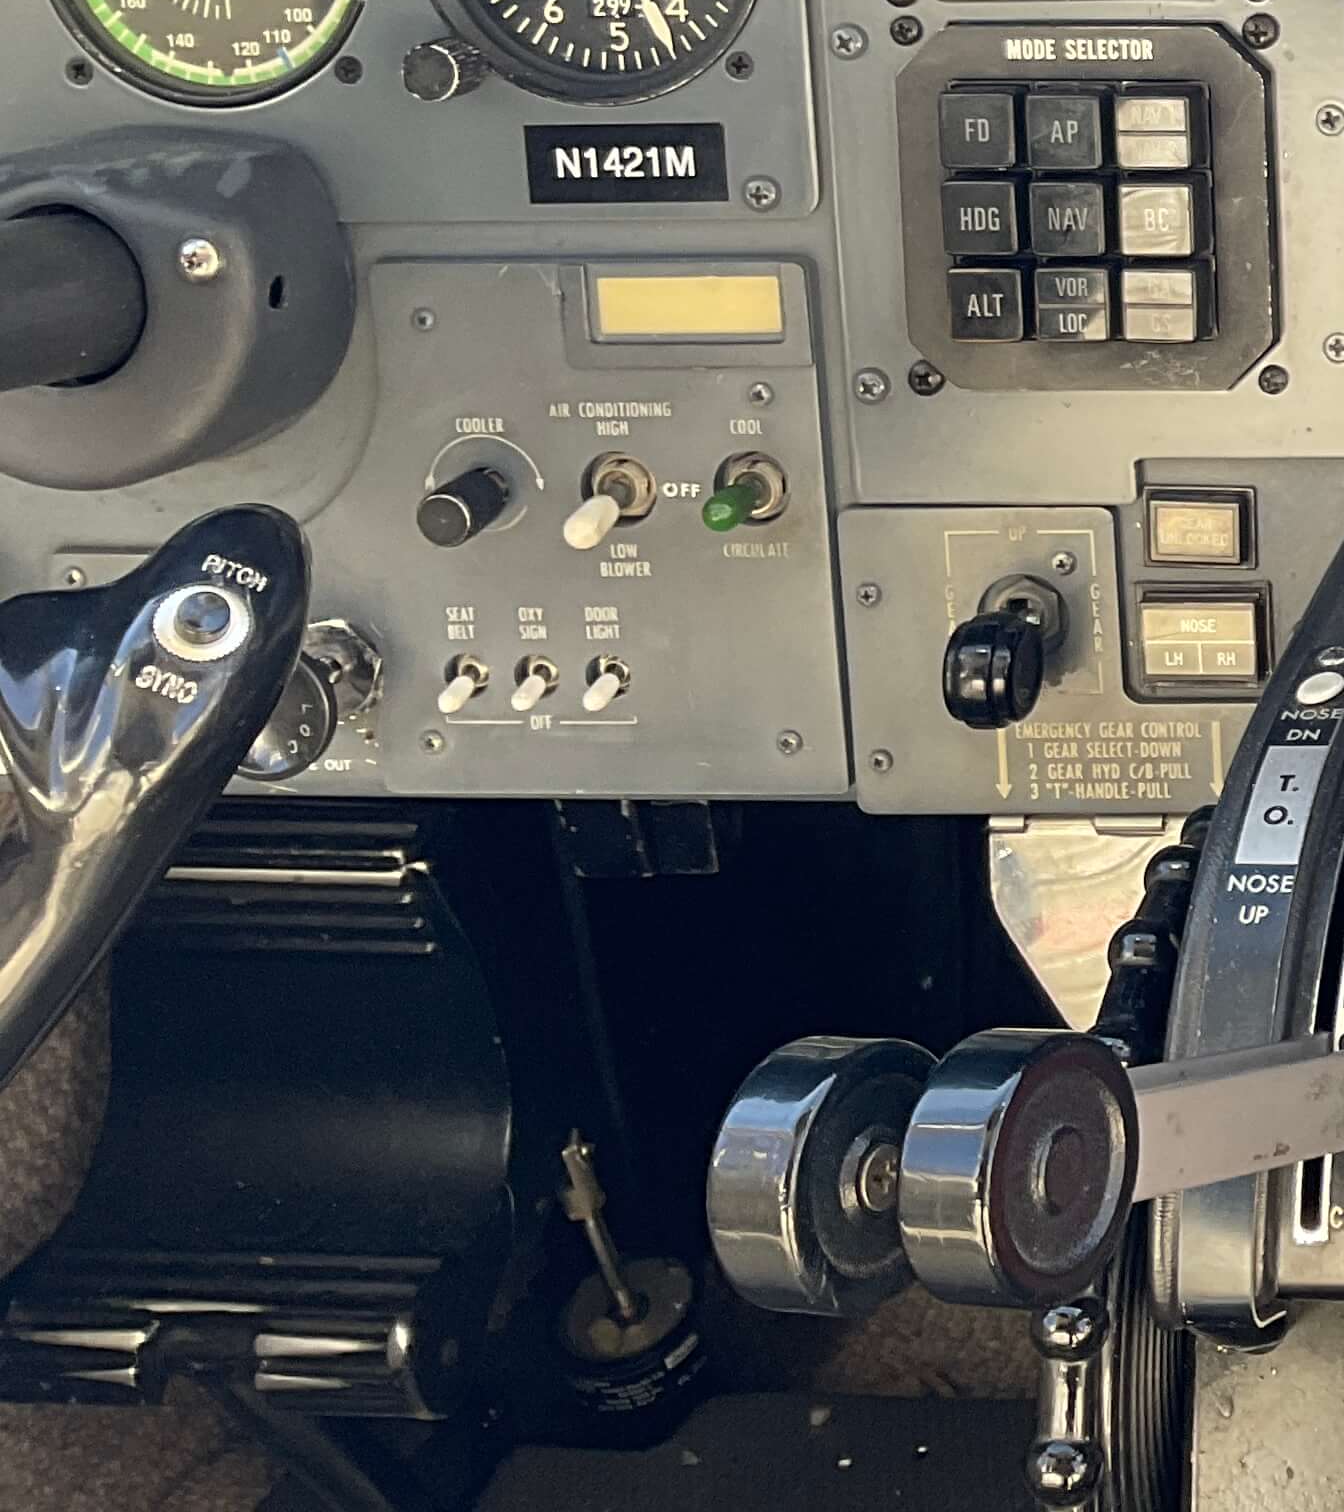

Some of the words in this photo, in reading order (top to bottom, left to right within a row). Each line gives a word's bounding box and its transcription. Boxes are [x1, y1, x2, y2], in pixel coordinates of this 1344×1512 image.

[1006, 39, 1055, 60] MODE
[1065, 39, 1153, 61] SELECTOR
[965, 119, 989, 143] FD
[1051, 120, 1078, 143] AP
[555, 148, 696, 178] N1421M
[961, 207, 1000, 231] HDG
[1048, 207, 1088, 231] NAV
[967, 294, 1003, 318] ALT
[549, 403, 570, 417] AIR
[579, 403, 672, 417] CONDITIONING
[456, 418, 503, 433] COOLER
[597, 421, 629, 435] HIGH
[664, 483, 701, 498] OFF
[1181, 620, 1216, 634] NOSE
[1282, 710, 1344, 720] NOSE
[1016, 722, 1091, 739] EMERGENCY
[1099, 722, 1136, 738] GEAR
[1141, 722, 1201, 738] CONTROL
[1286, 729, 1320, 740] DN
[1028, 743, 1033, 757] 1
[1044, 743, 1080, 757] GEAR
[1086, 742, 1181, 757] SELECT-DOWN
[1228, 876, 1294, 893] NOSE
[1239, 906, 1269, 923] UP
